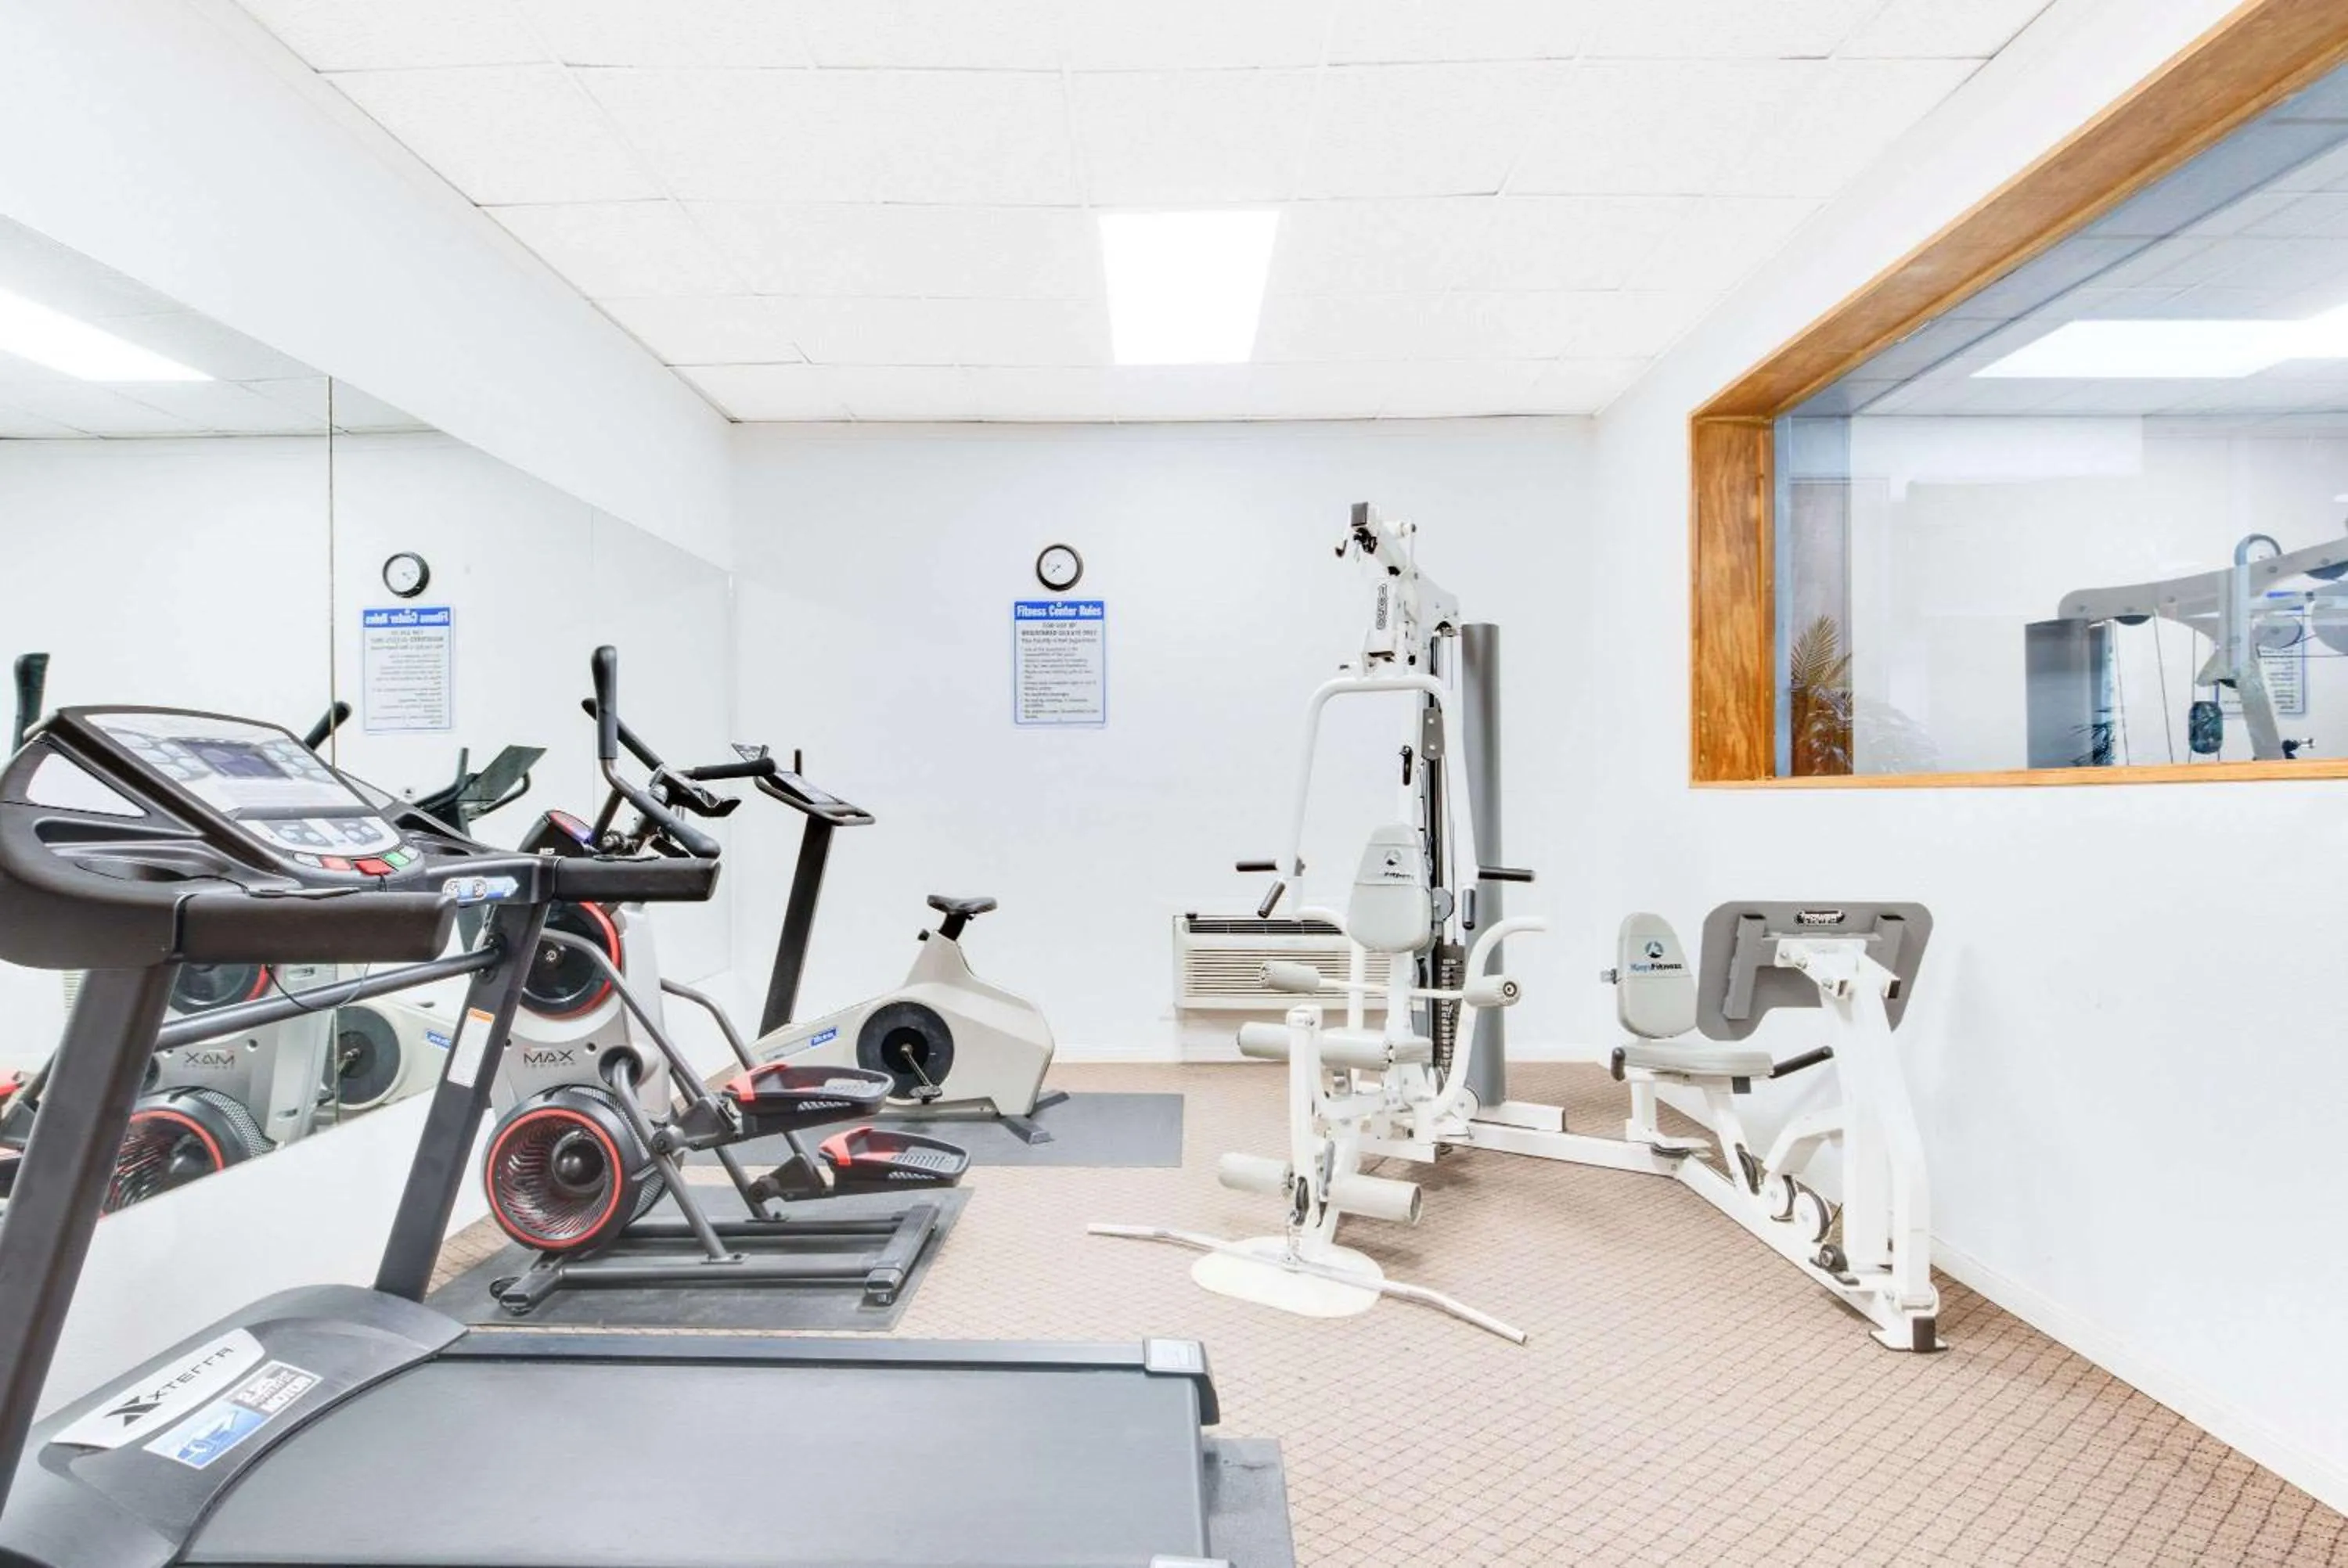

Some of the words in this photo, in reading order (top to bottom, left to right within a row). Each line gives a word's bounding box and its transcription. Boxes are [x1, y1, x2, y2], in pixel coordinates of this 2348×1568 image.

[1017, 605, 1046, 617] Fitness
[1049, 605, 1077, 617] Center
[1079, 605, 1102, 616] Rules
[523, 1049, 574, 1063] MAX
